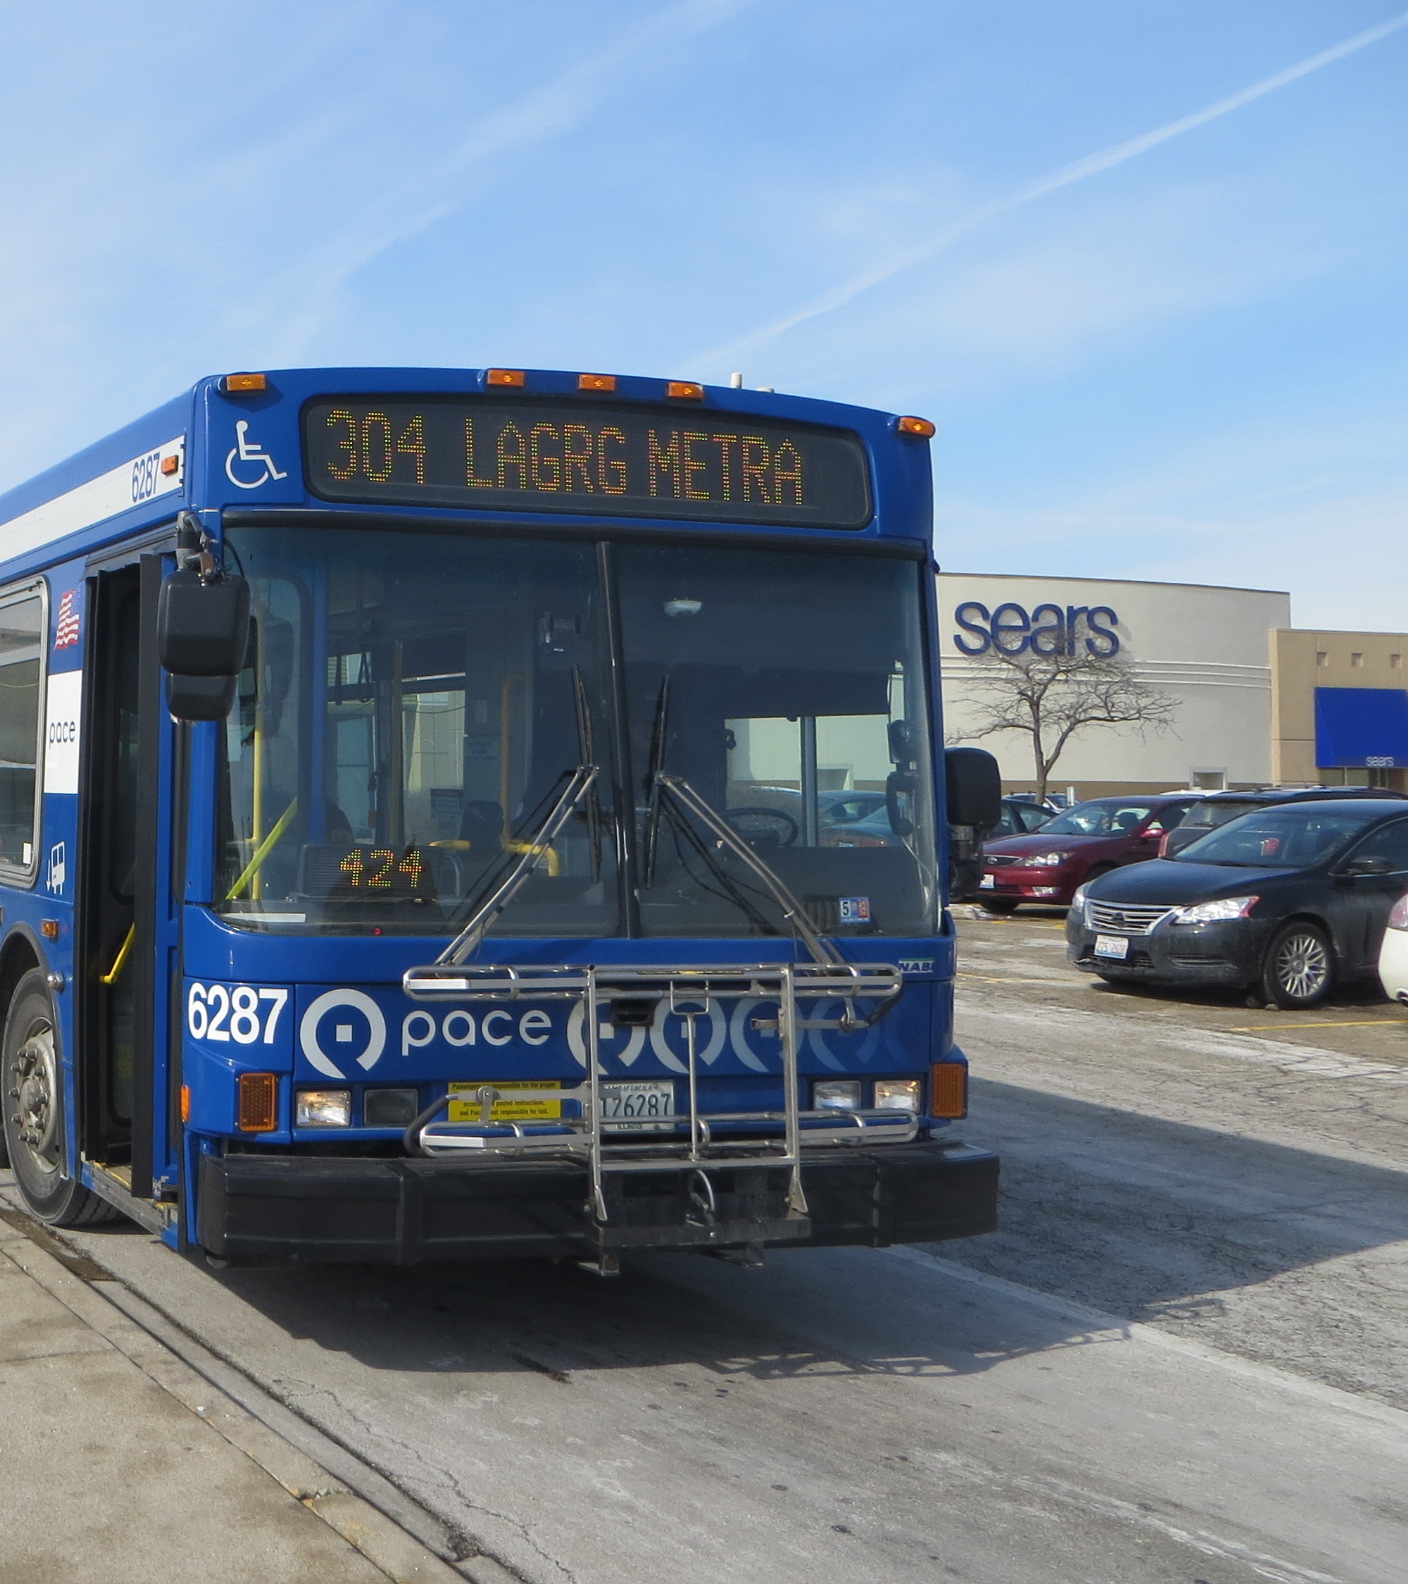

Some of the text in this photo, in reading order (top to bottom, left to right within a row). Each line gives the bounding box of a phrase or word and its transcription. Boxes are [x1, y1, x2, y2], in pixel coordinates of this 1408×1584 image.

[132, 452, 160, 503] 6287
[327, 410, 802, 505] 304 LAGRG METRA
[953, 601, 1119, 659] sears
[49, 720, 76, 749] pace
[1366, 756, 1394, 767] sears
[340, 849, 423, 887] 424
[842, 901, 850, 916] 5
[187, 982, 289, 1045] 6287
[401, 1009, 553, 1057] pace
